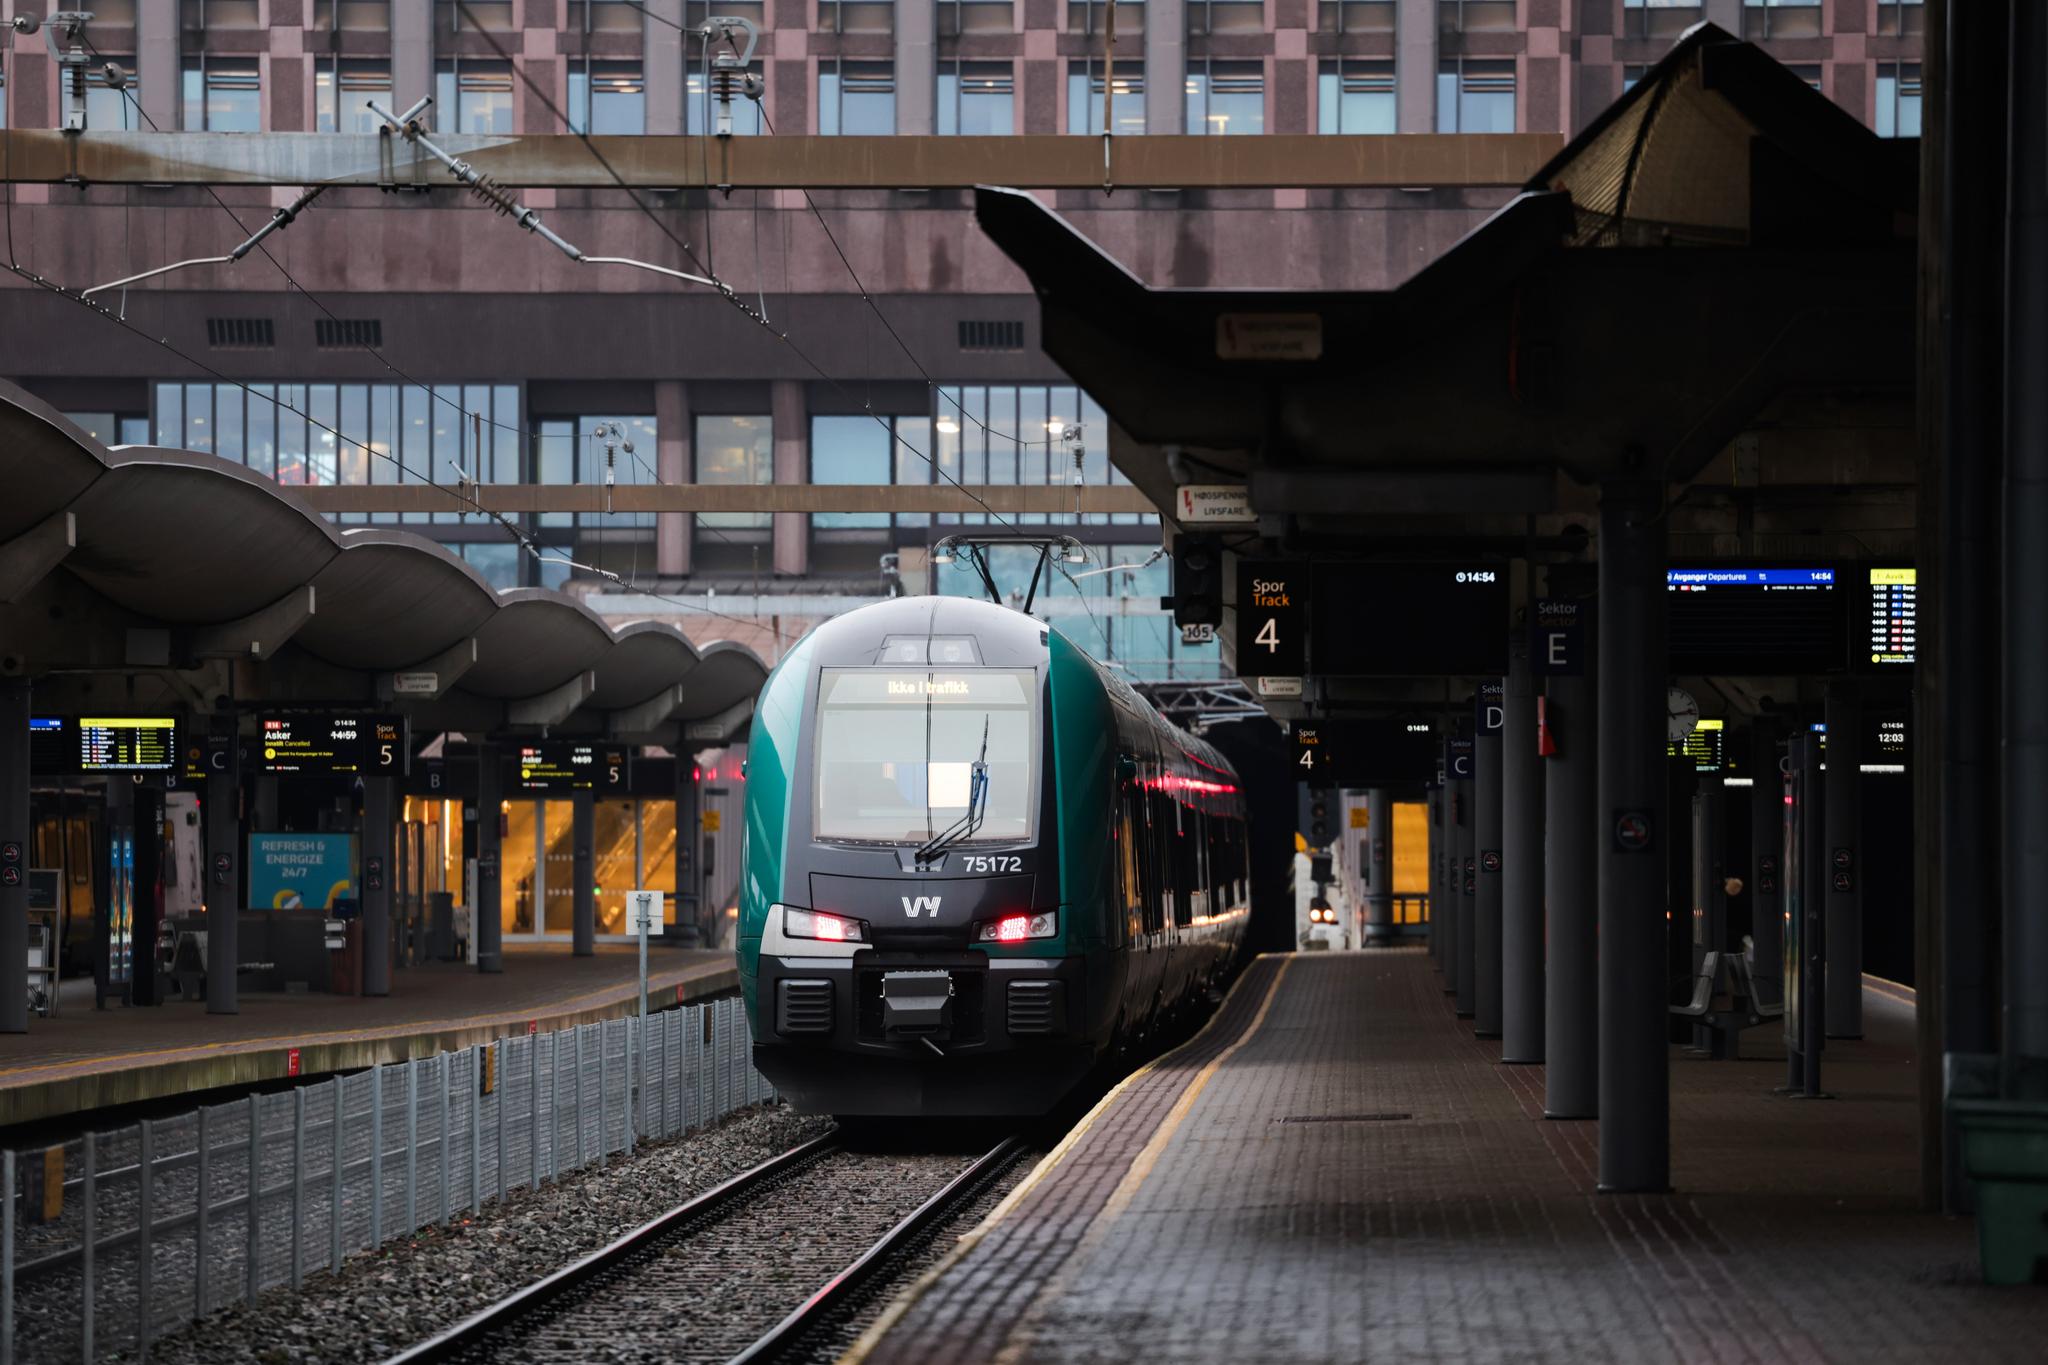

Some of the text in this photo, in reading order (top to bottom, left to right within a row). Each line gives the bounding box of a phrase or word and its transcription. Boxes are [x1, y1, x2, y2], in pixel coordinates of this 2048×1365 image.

[1204, 507, 1245, 516] LIVSFARE
[1467, 571, 1496, 582] 14:54
[1673, 573, 1707, 582] Avganger
[1708, 573, 1747, 582] Departures
[1253, 579, 1285, 594] Spor
[1253, 593, 1290, 606] Track
[1539, 602, 1578, 614] Sektor
[1187, 627, 1209, 638] 105
[1255, 618, 1280, 653] 4
[1548, 633, 1567, 664] E
[888, 680, 915, 694] Ikke
[926, 680, 969, 694] trafikk
[1482, 684, 1505, 693] Sekto
[1486, 706, 1504, 729] D
[377, 724, 394, 733] Spor
[1298, 728, 1316, 738] Spor
[265, 730, 291, 740] Asker
[377, 732, 396, 740] Track
[1878, 733, 1904, 742] 12:03
[212, 751, 225, 769] C
[380, 744, 393, 765] 5
[1299, 749, 1314, 770] 4
[1455, 756, 1468, 774] C
[430, 773, 441, 788] B
[609, 766, 619, 783] 5
[261, 841, 326, 851] REFRESH &
[266, 854, 324, 865] ENERGIZE
[963, 856, 1022, 872] 75172
[281, 867, 307, 878] 24/7
[902, 896, 942, 918] VY
